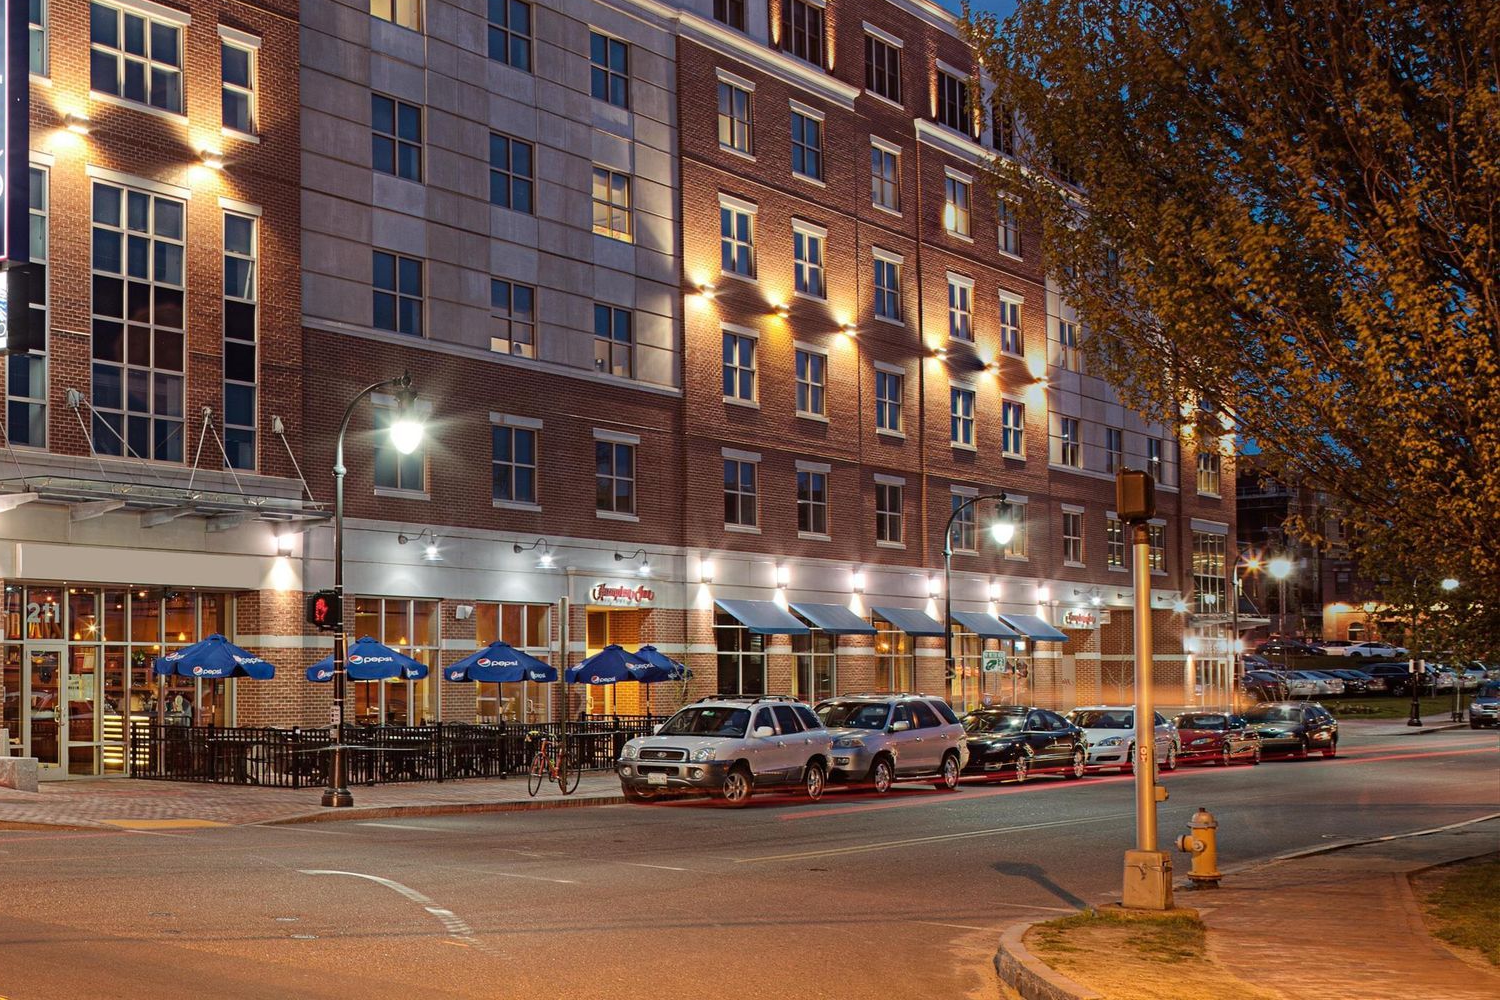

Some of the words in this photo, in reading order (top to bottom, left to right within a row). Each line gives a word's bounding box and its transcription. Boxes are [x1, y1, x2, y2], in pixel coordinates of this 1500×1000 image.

[27, 602, 60, 623] 211
[363, 656, 393, 664] pepsi
[491, 660, 518, 668] pepsi
[203, 668, 222, 676] pepsi
